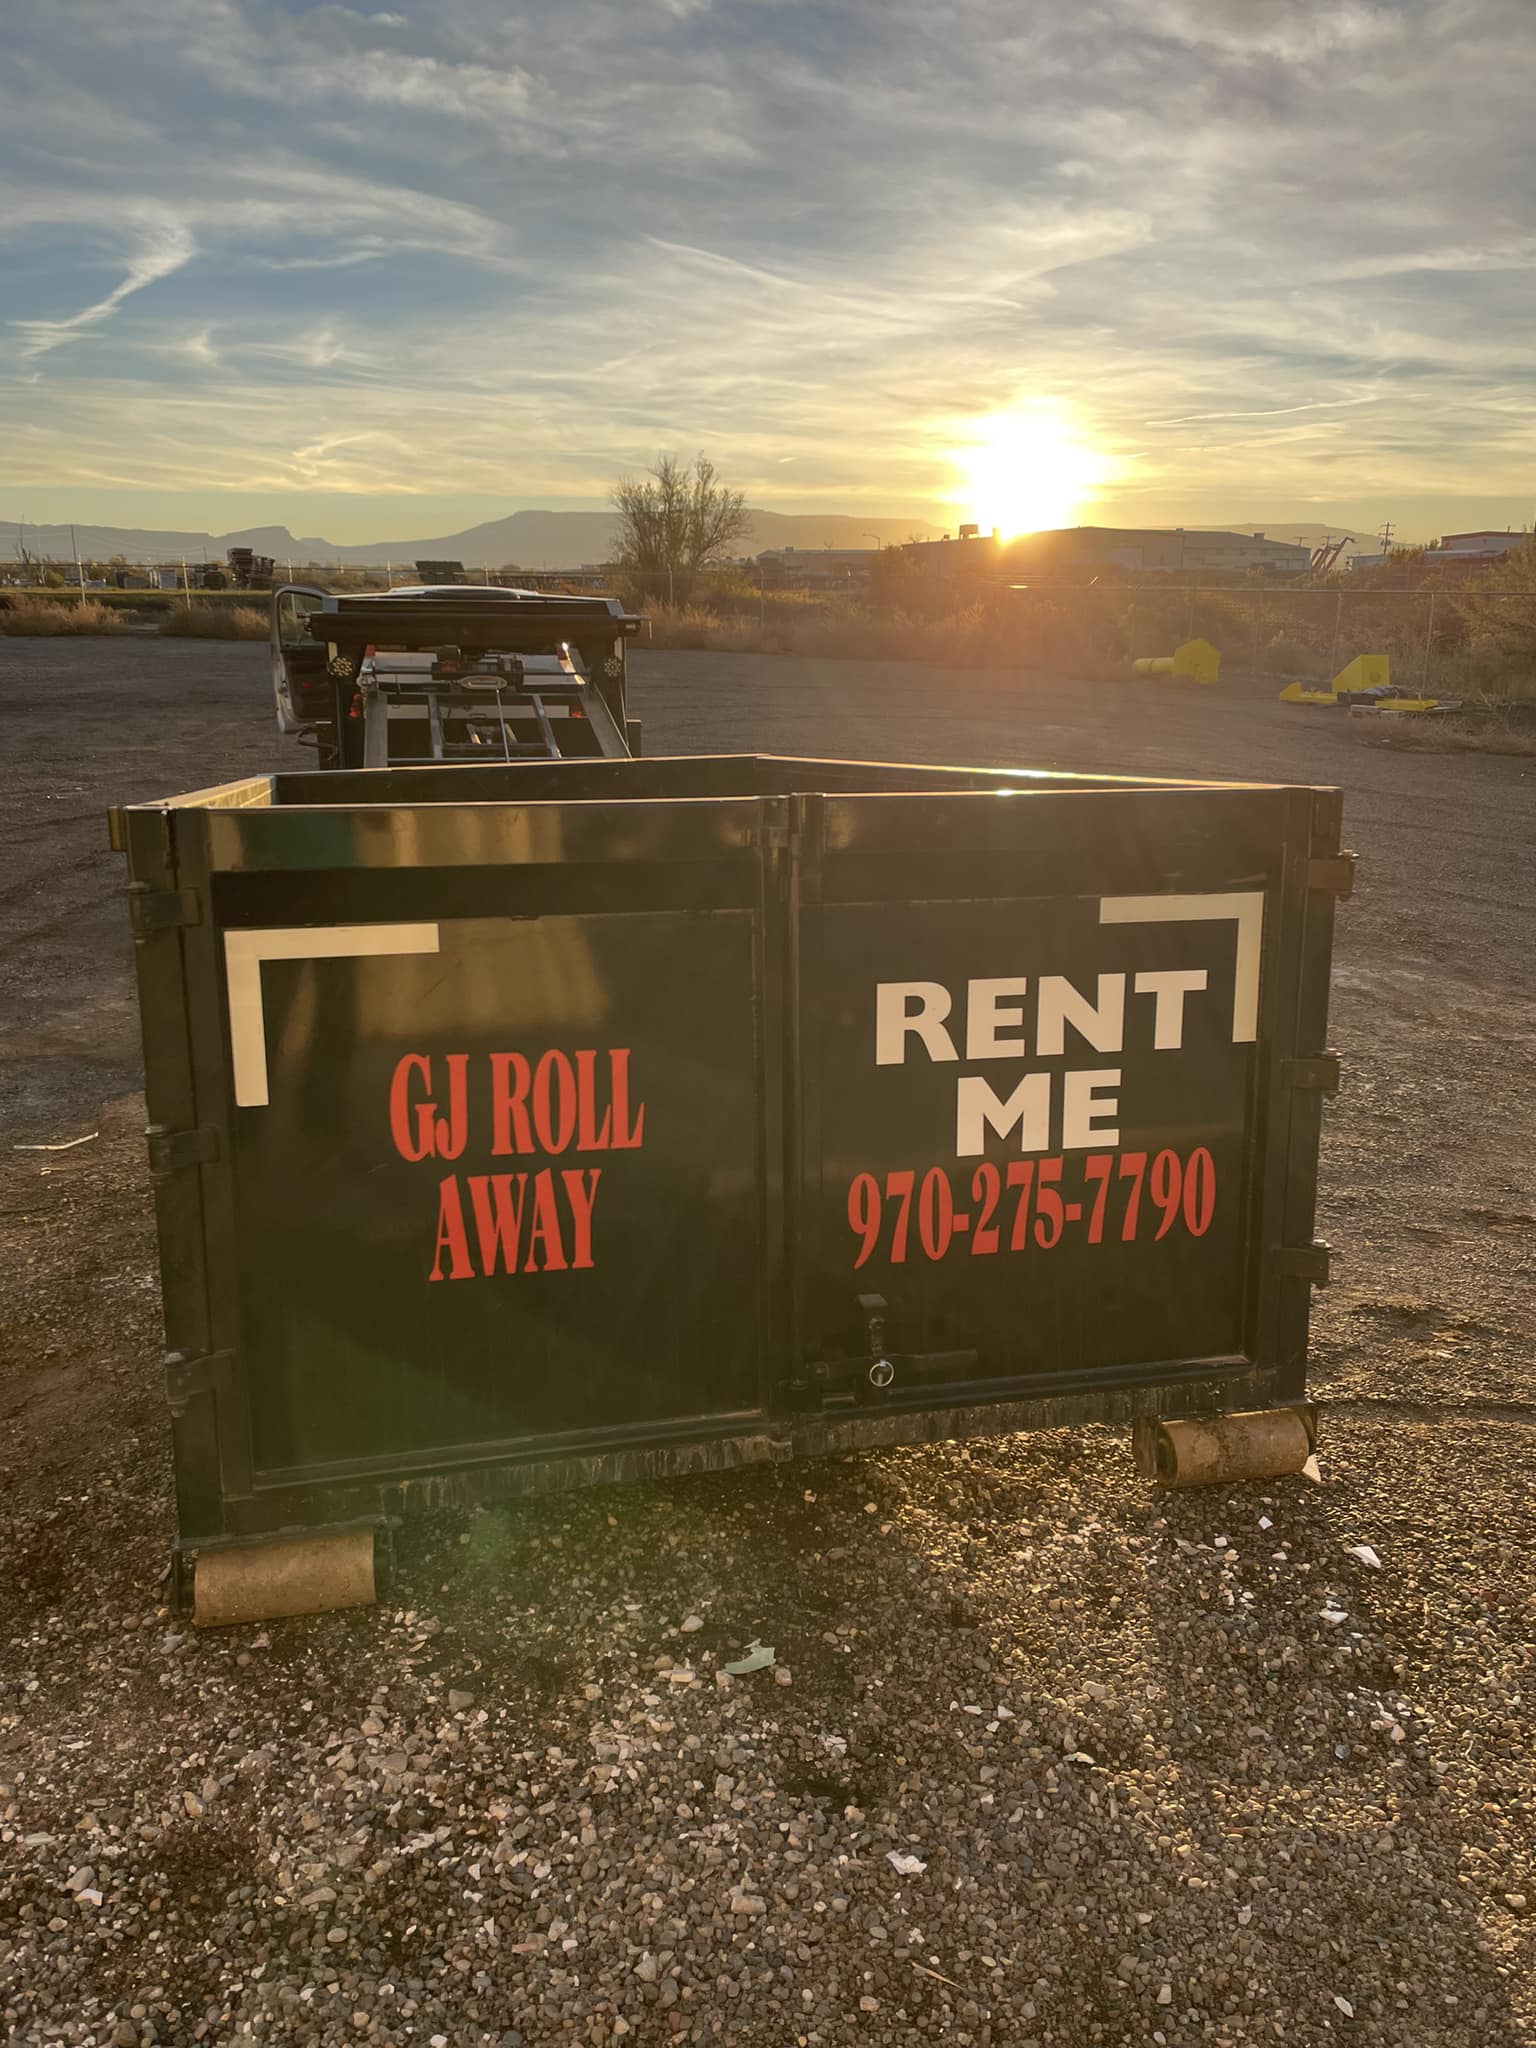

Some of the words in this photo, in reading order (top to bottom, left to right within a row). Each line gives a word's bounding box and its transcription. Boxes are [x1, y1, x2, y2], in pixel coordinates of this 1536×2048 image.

[875, 969, 1208, 1066] RENT
[389, 1053, 468, 1162] GJ
[489, 1049, 644, 1156] ROLL
[956, 1068, 1122, 1157] ME
[429, 1168, 601, 1281] AWAY
[848, 1147, 1216, 1269] 970-275-7790
